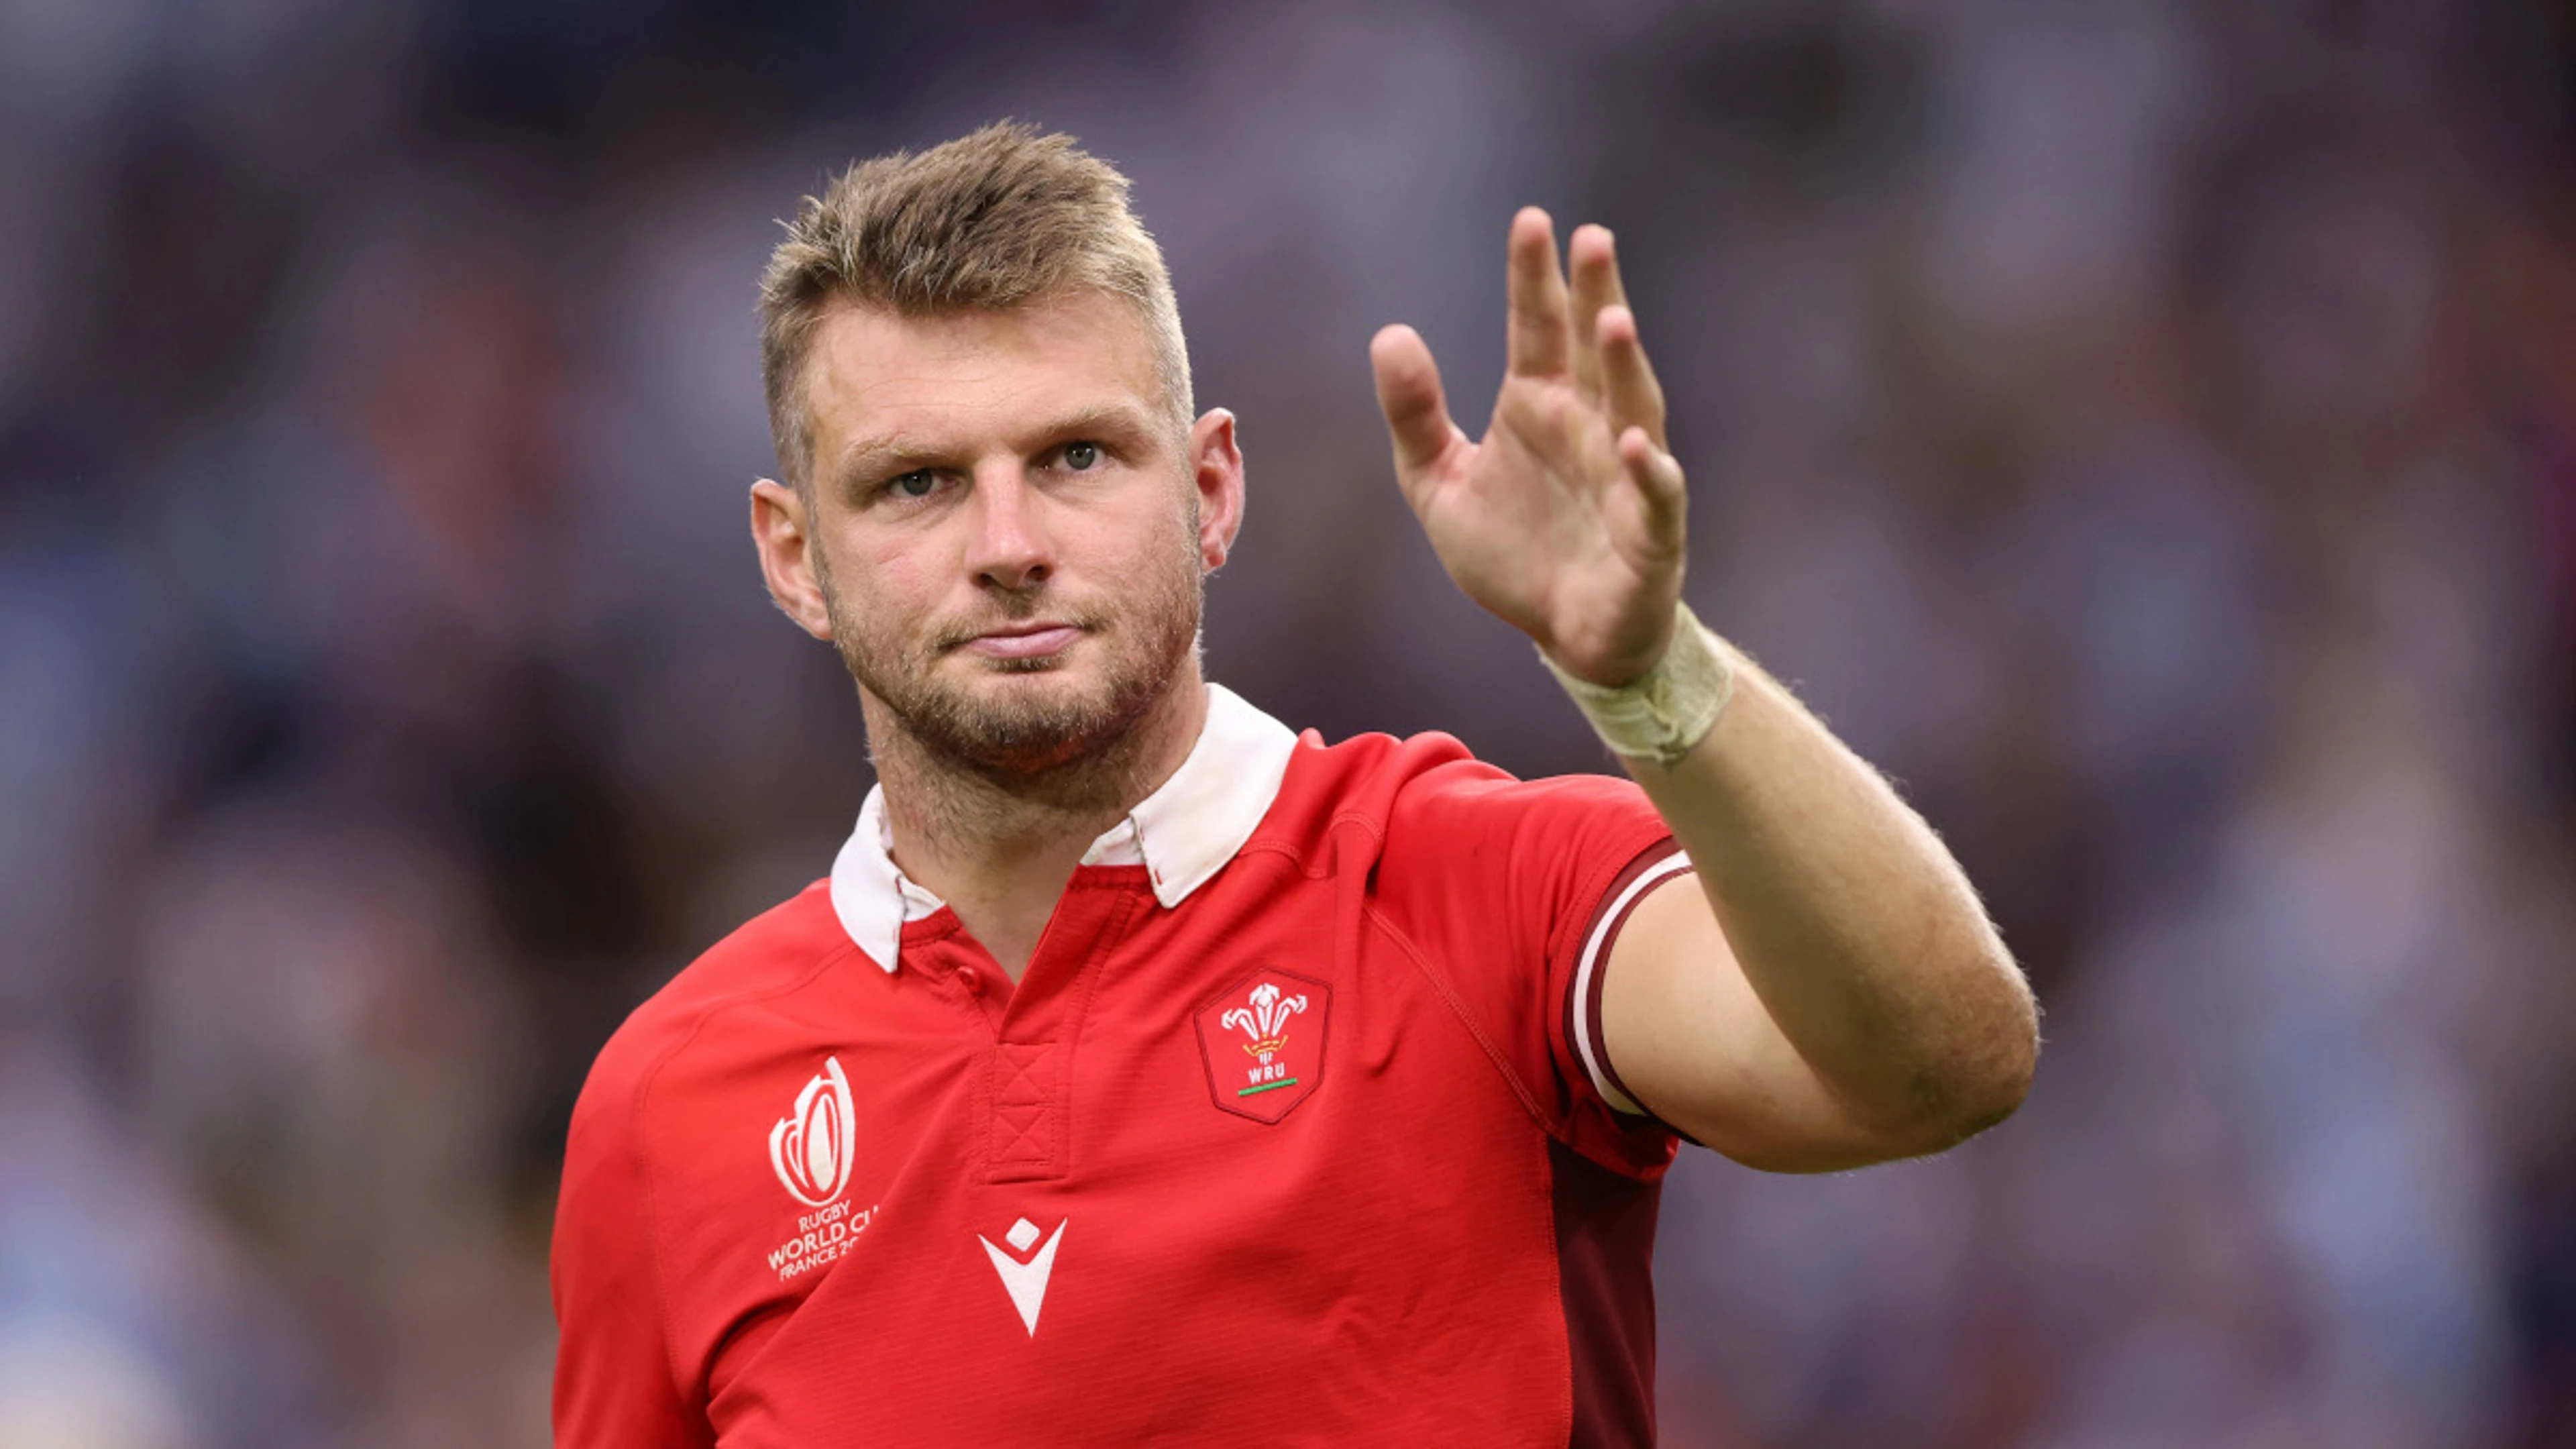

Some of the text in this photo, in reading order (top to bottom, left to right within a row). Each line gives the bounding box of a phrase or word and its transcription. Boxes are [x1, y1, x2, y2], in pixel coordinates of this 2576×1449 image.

[1248, 1063, 1285, 1084] WRU
[798, 1199, 851, 1232] RUGBY
[768, 1222, 846, 1270] WORLD
[780, 1245, 838, 1282] FRANCE
